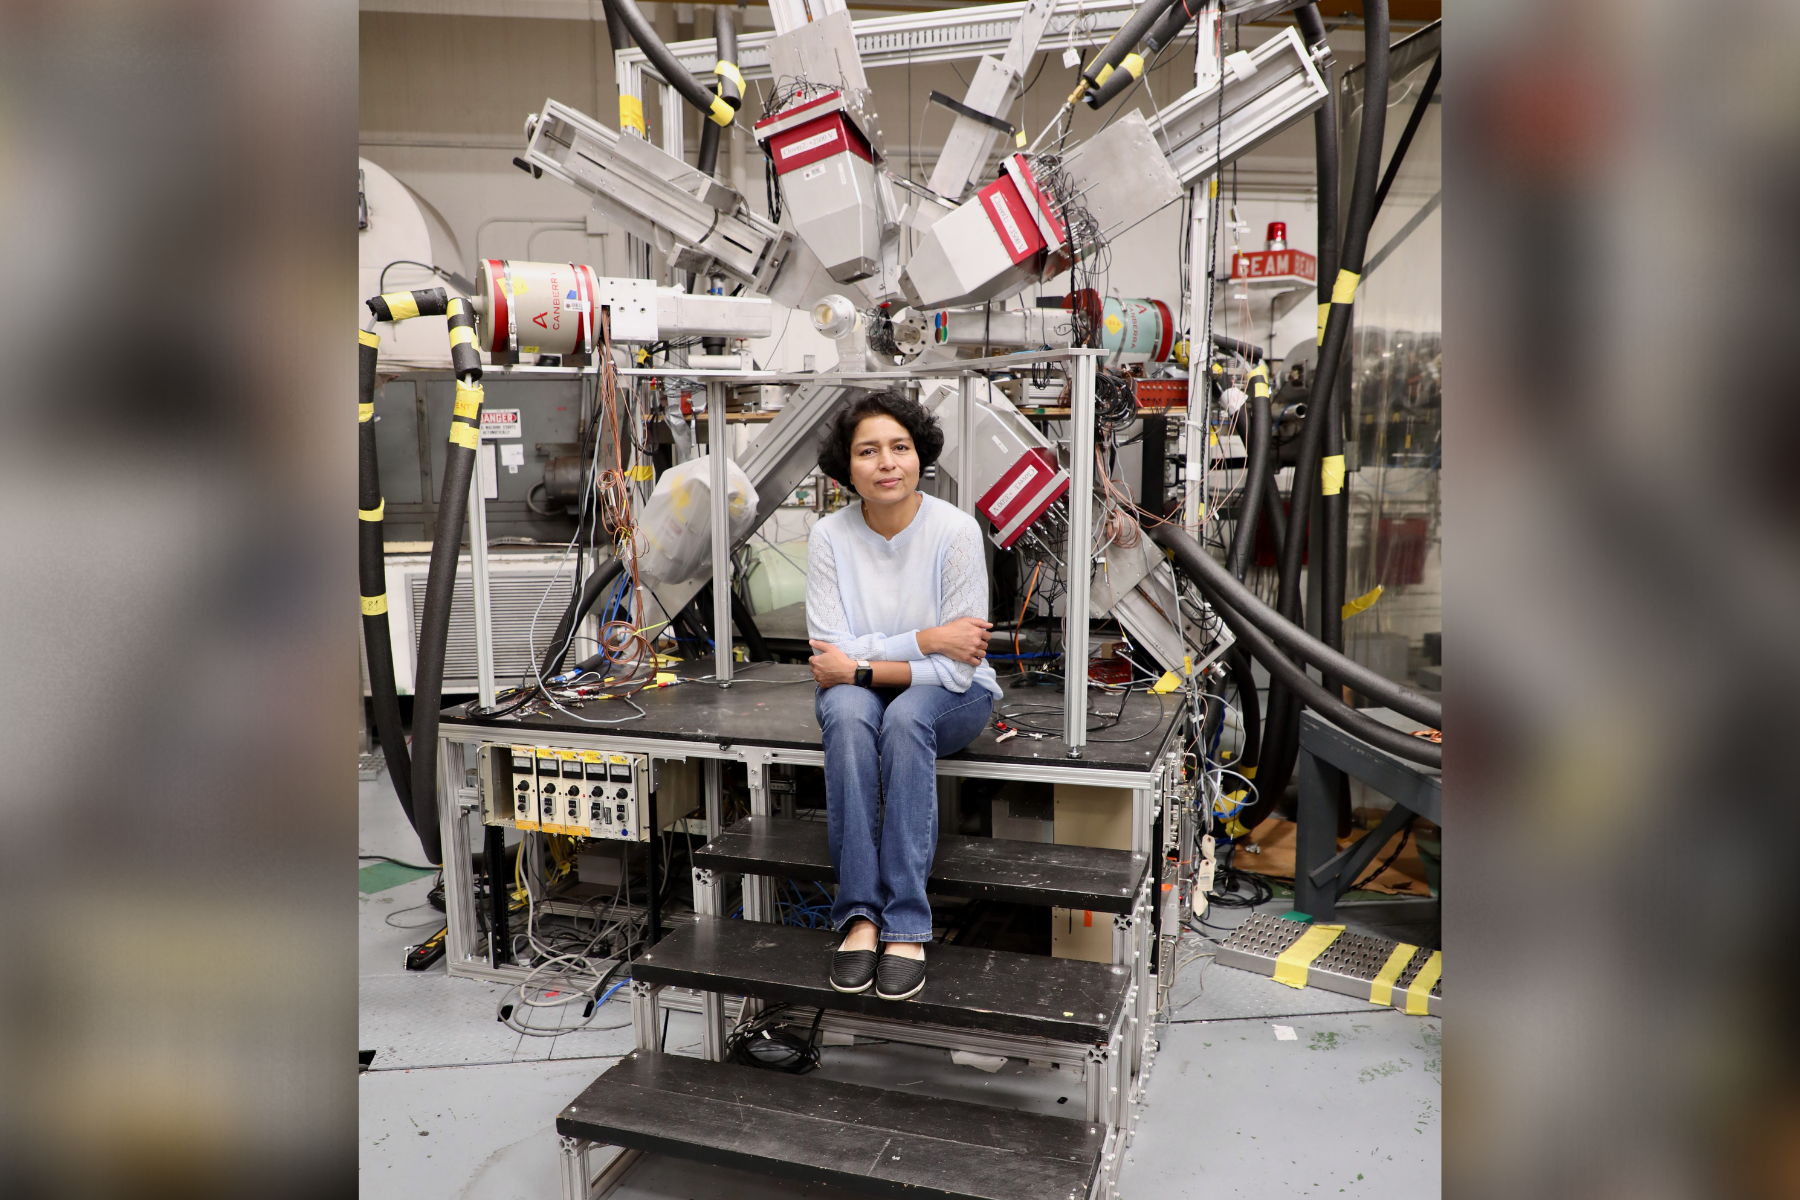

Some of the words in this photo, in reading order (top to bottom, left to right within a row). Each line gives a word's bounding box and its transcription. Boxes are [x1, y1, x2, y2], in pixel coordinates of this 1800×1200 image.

[782, 143, 808, 156] Clover2:
[1238, 254, 1289, 276] BEAM
[1294, 254, 1314, 278] BEAM
[1126, 303, 1138, 349] CANBERRA
[1014, 468, 1035, 490] Clover3:
